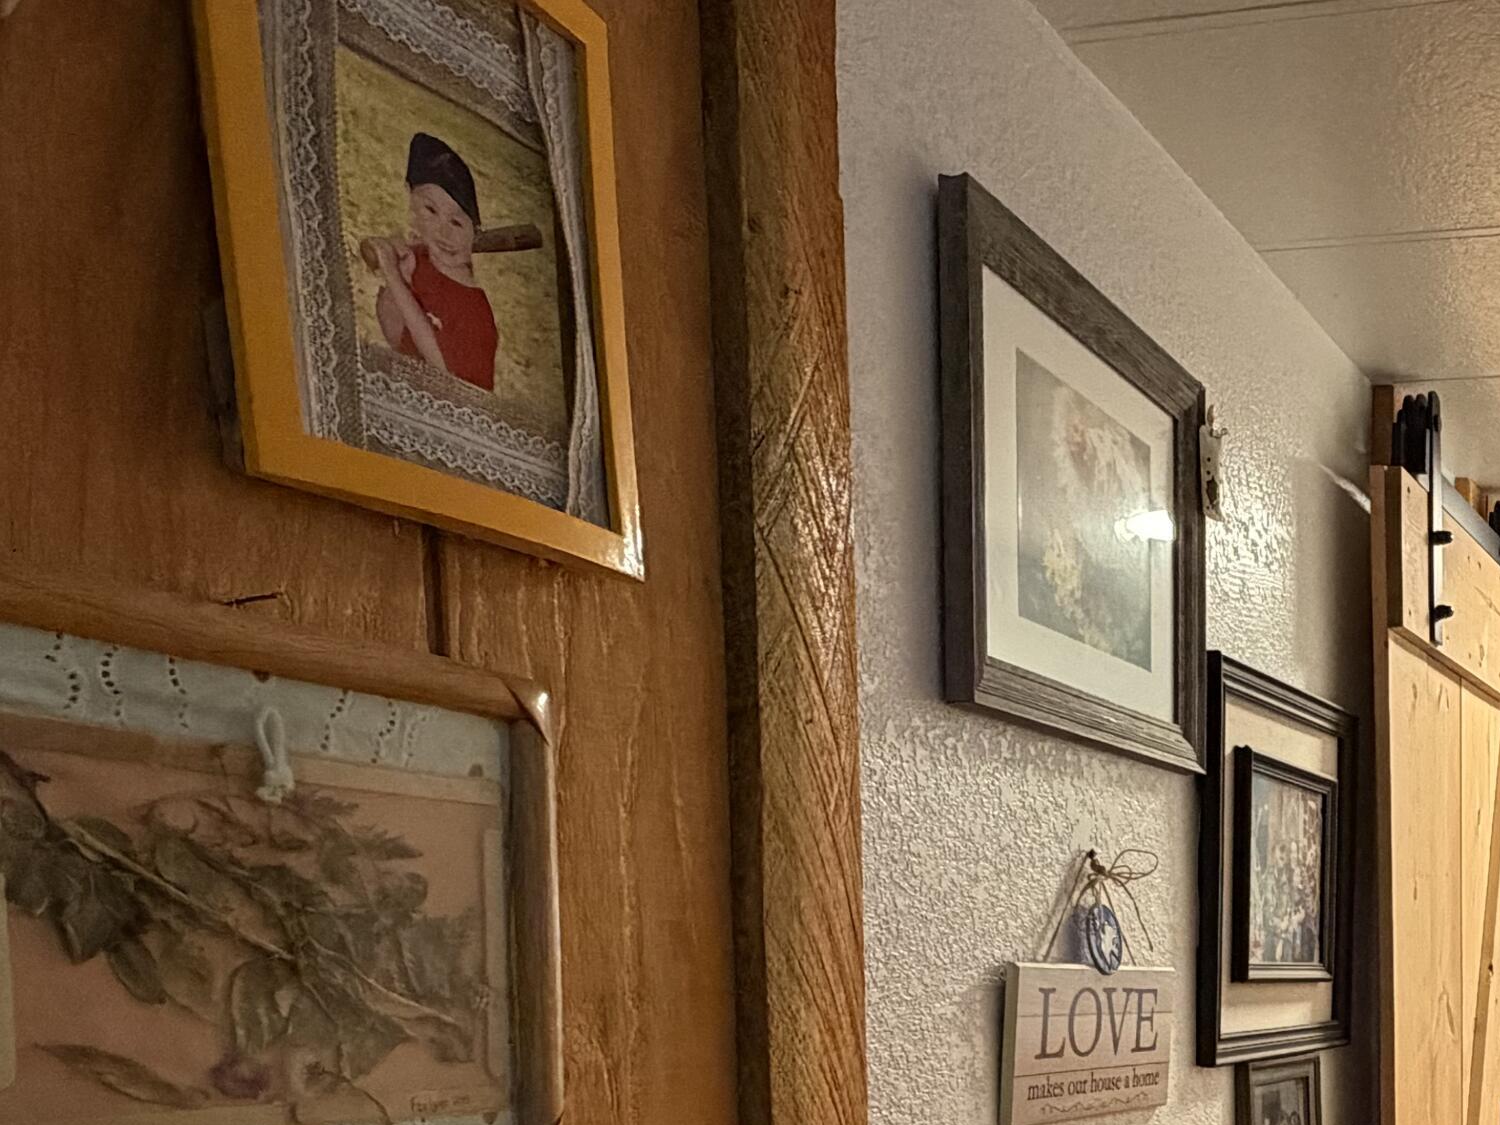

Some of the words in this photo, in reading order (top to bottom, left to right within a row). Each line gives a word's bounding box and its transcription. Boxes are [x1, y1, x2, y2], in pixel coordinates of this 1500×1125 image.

[1034, 987, 1159, 1060] LOVE
[1027, 1076, 1065, 1100] makes
[1068, 1079, 1088, 1096] our
[1090, 1071, 1122, 1093] house
[1124, 1075, 1130, 1088] a
[1132, 1067, 1160, 1087] home
